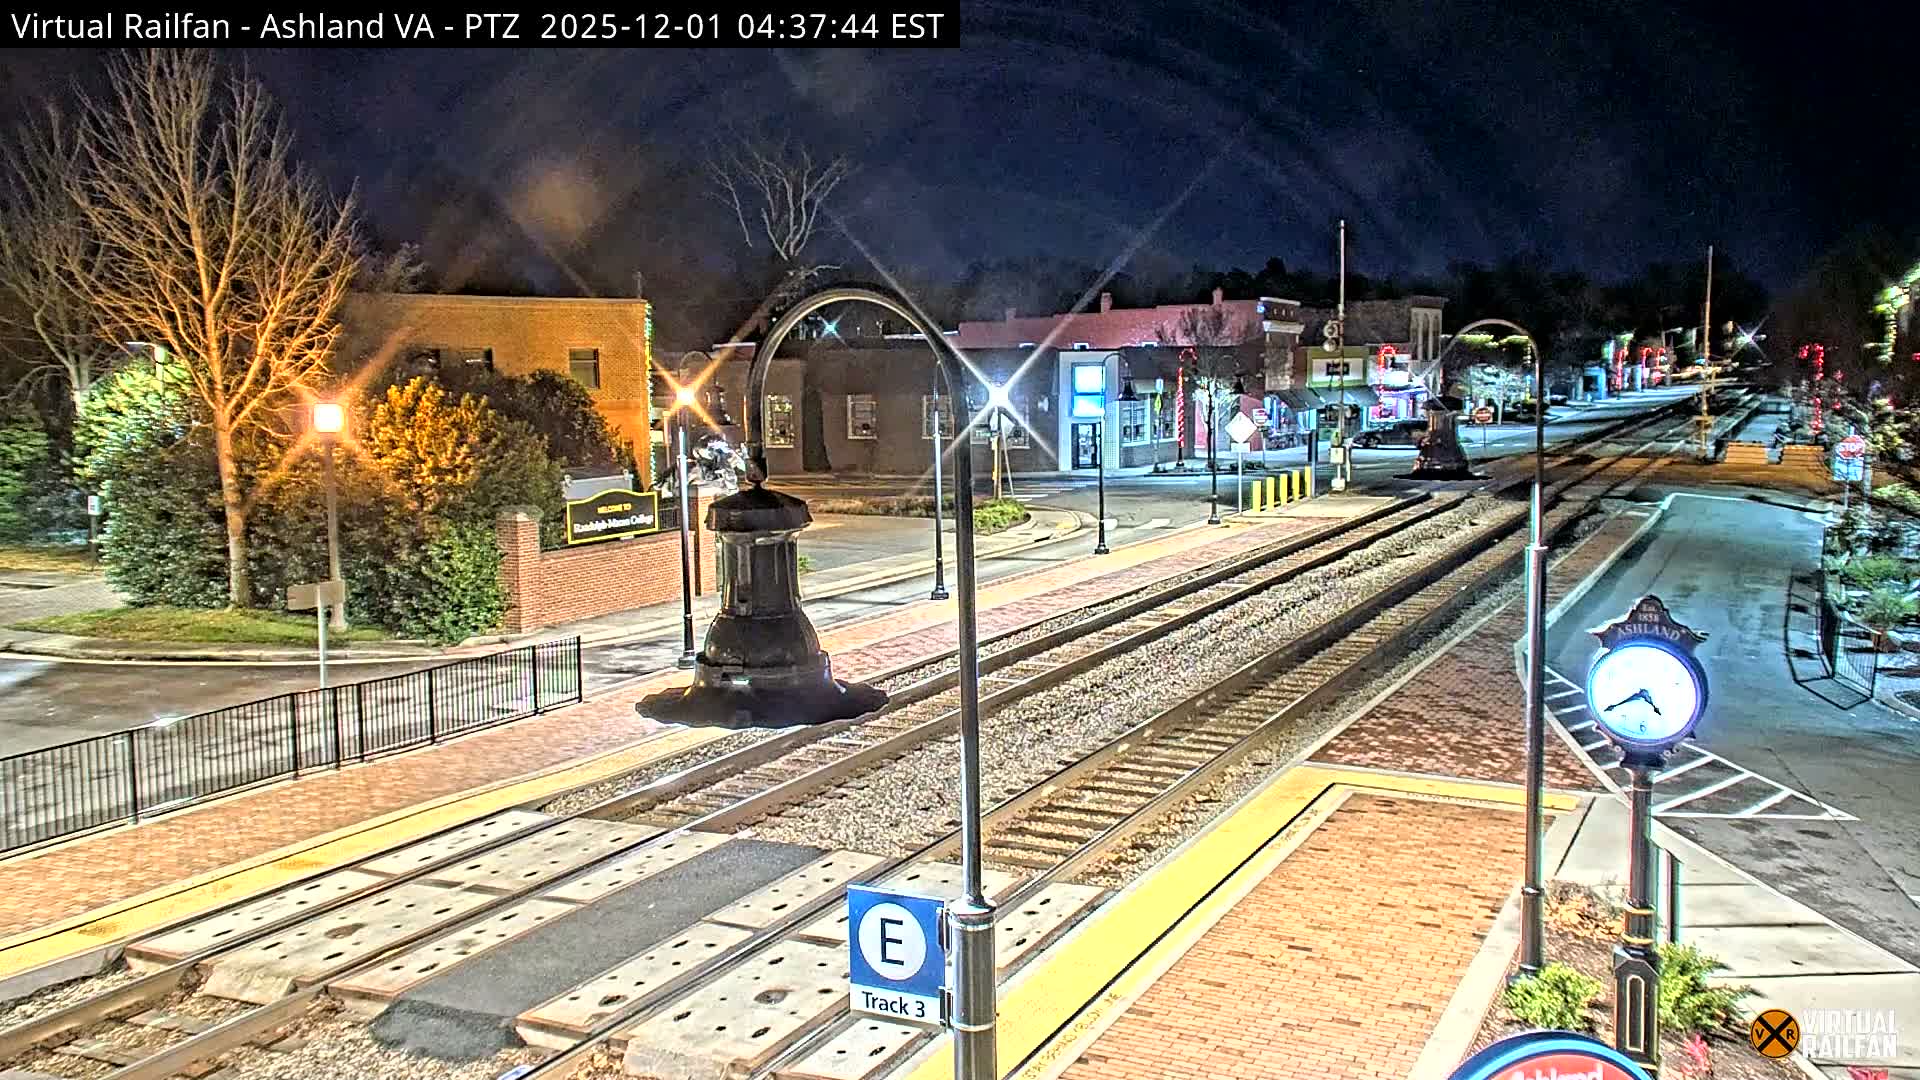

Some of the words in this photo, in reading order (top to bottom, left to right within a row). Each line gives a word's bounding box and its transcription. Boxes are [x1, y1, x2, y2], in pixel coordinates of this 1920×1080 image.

[1617, 623, 1681, 641] ASHLAND
[880, 917, 904, 966] E
[861, 990, 909, 1016] Track
[915, 1000, 926, 1018] 3
